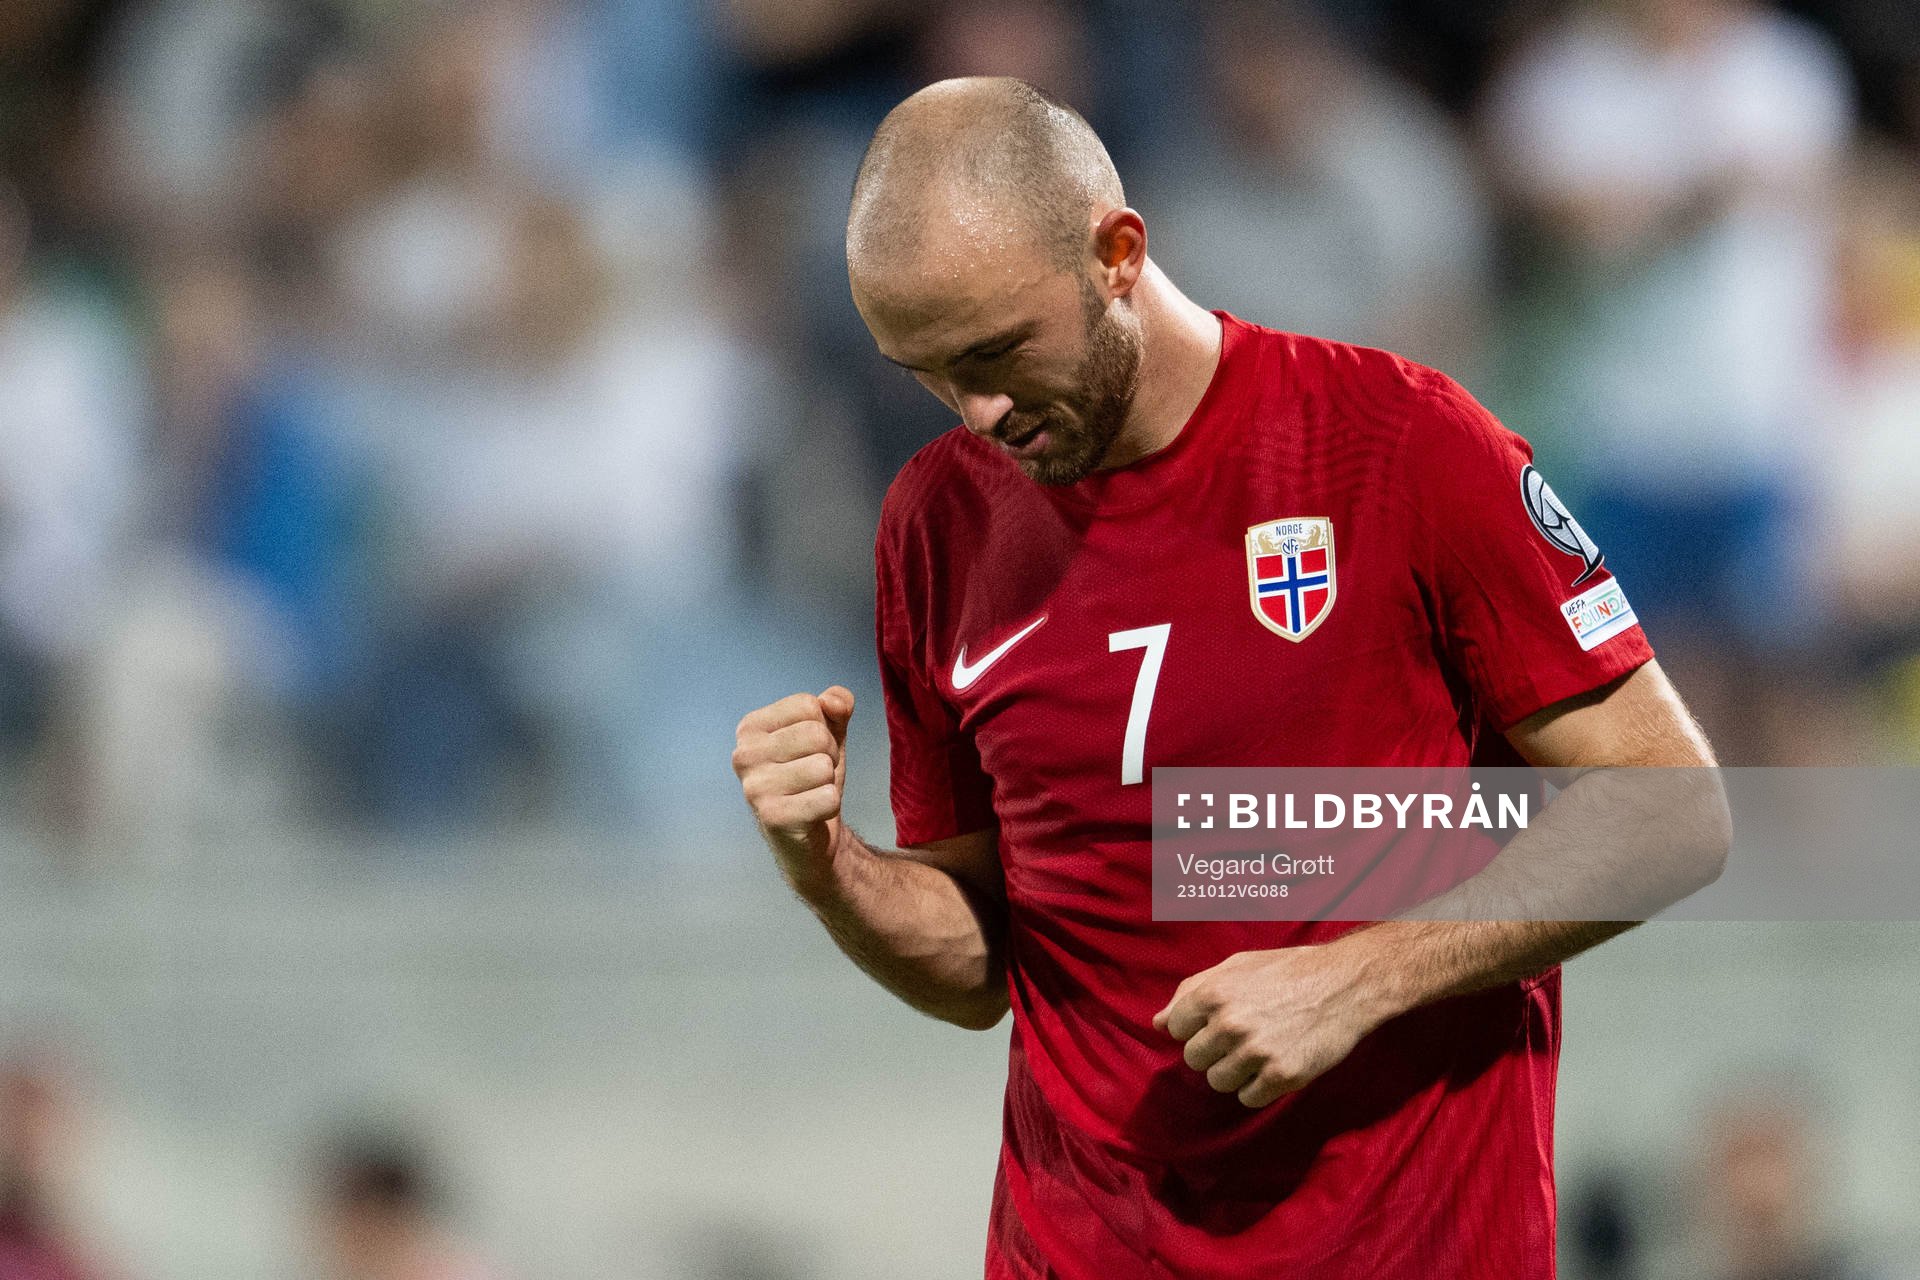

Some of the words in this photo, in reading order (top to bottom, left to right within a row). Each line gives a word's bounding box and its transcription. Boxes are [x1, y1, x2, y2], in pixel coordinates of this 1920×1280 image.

[1275, 523, 1303, 536] NORGE
[1565, 599, 1587, 616] UEFA
[1108, 623, 1171, 785] 7
